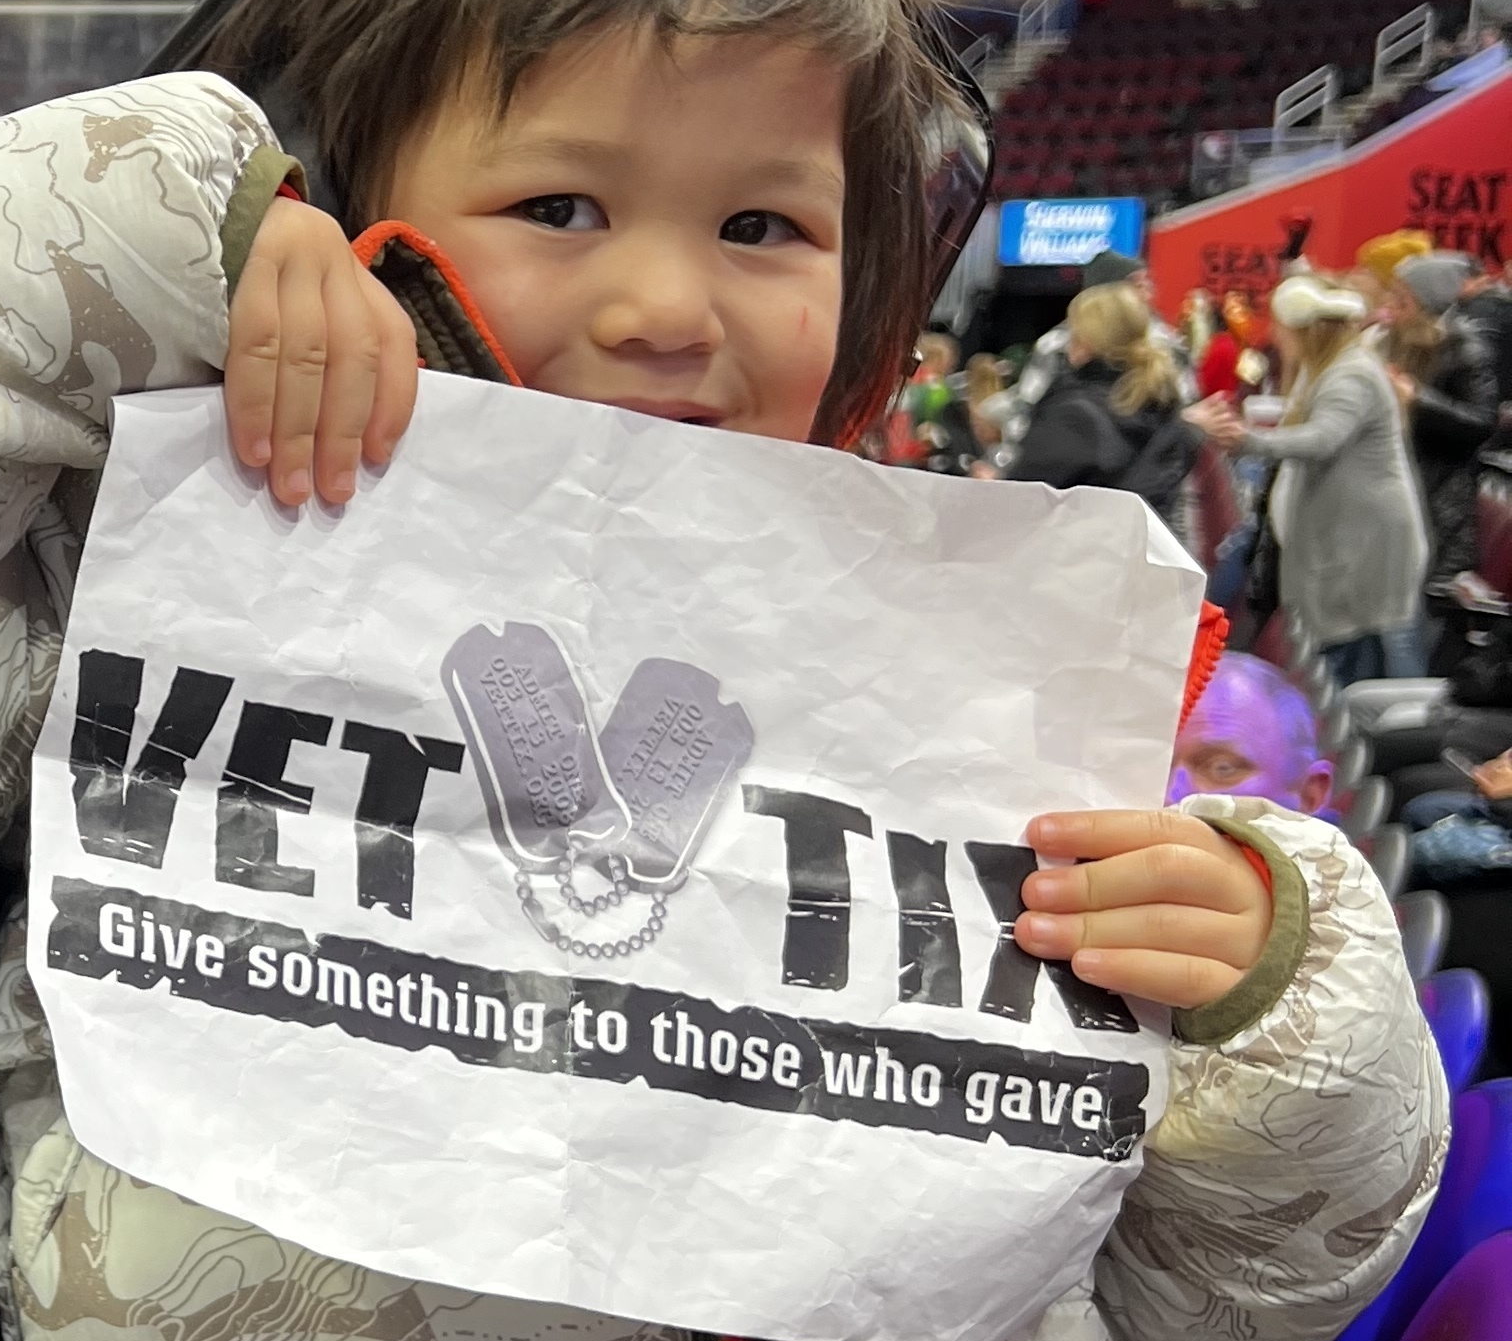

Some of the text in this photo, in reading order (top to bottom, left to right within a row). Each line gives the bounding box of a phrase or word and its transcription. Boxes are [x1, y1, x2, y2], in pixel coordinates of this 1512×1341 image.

[1409, 164, 1507, 214] SEAT
[491, 658, 523, 702] 003
[513, 664, 566, 741] ADMIT
[69, 648, 1140, 1034] VET TIX
[99, 902, 1105, 1132] Give something to those who gave
